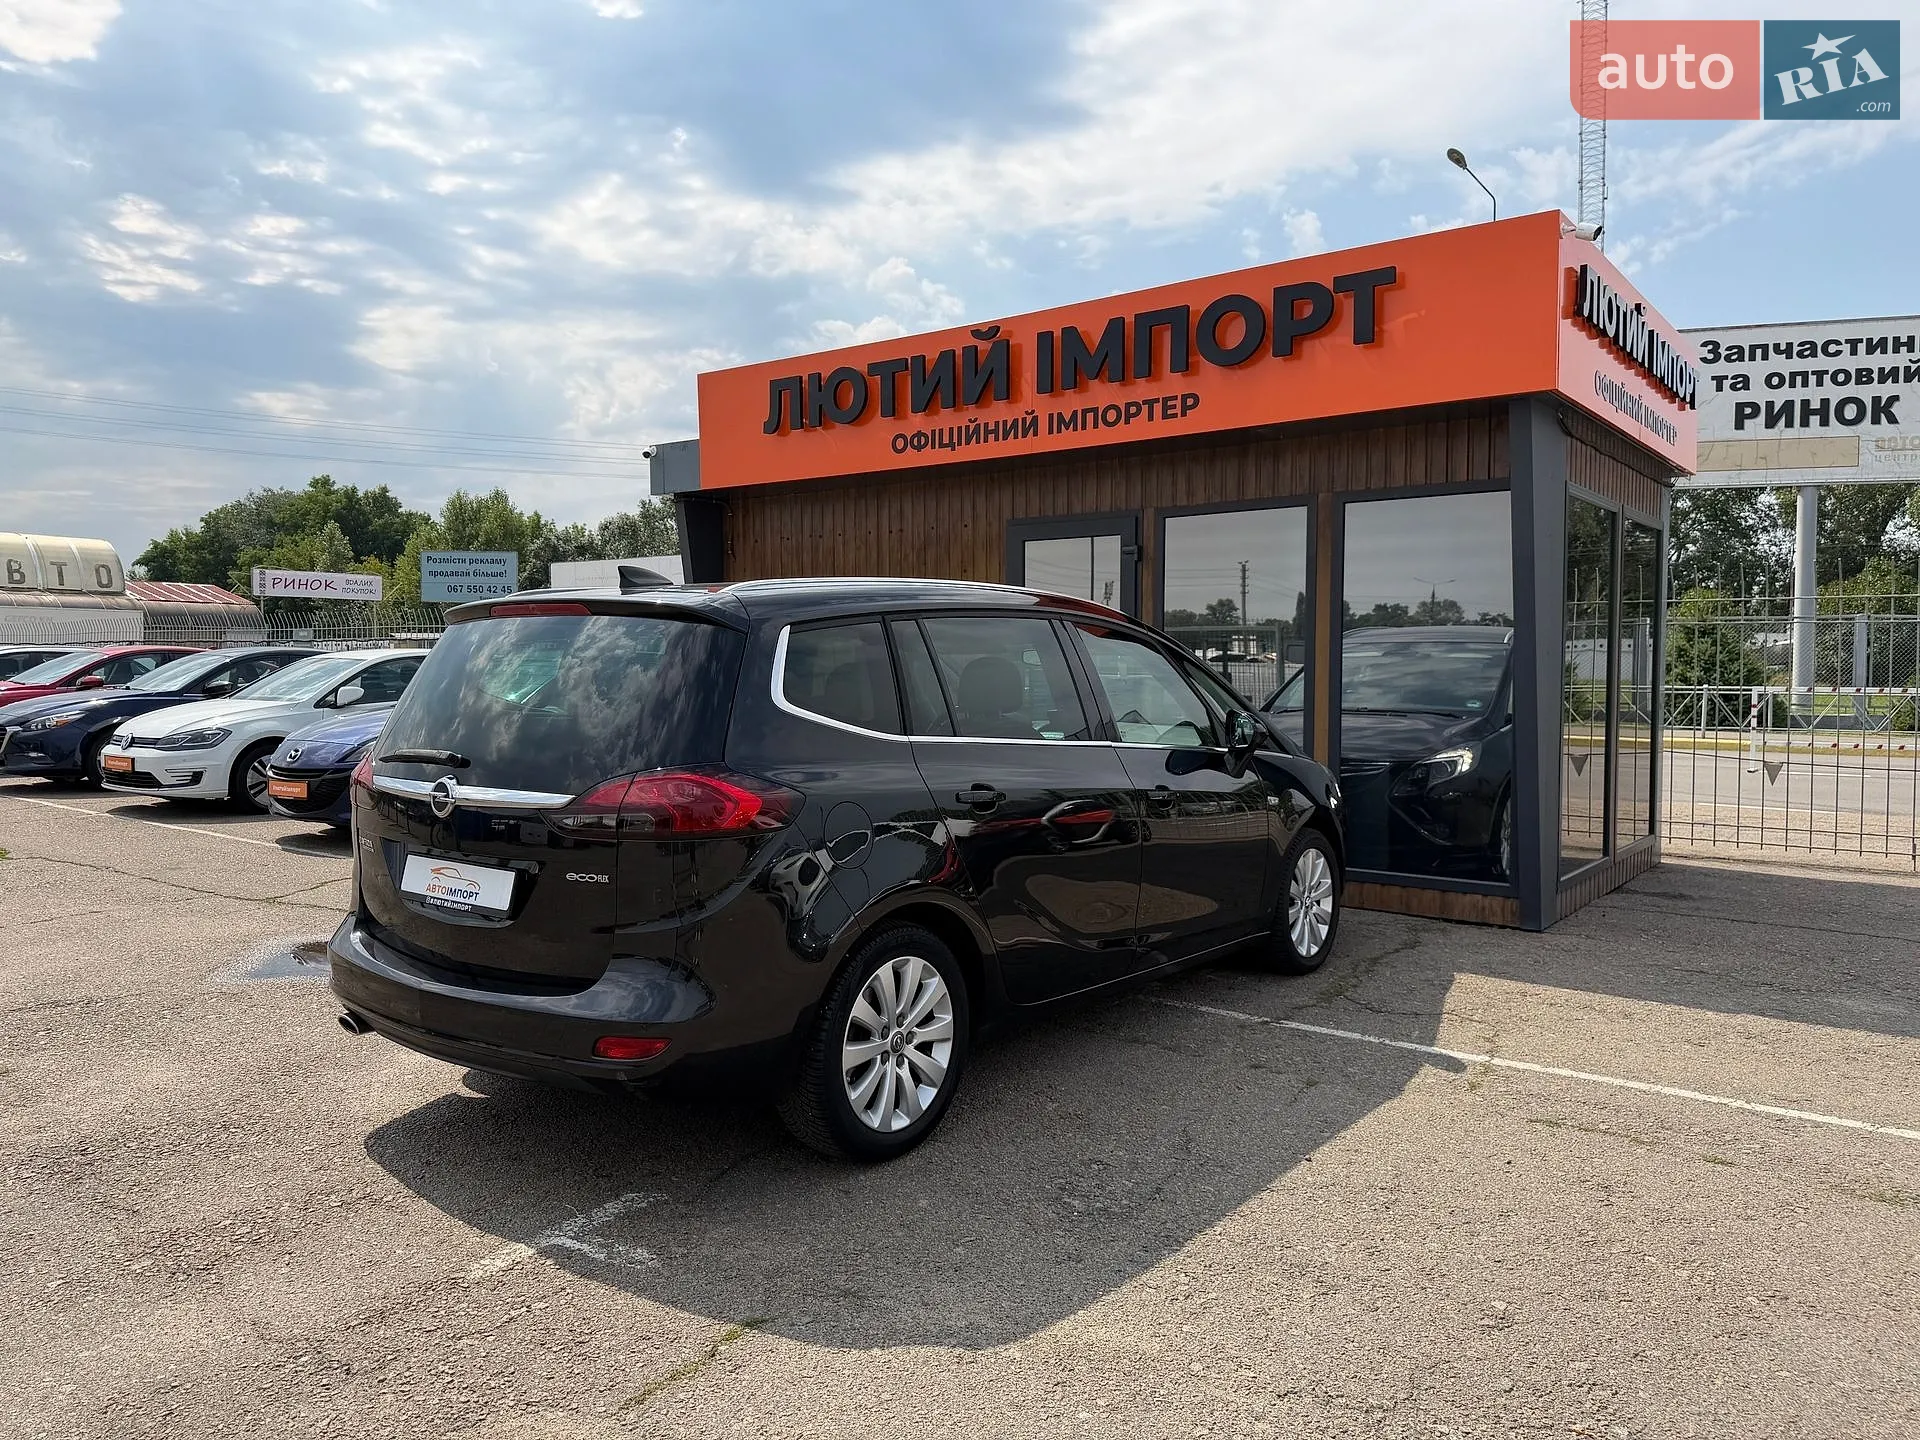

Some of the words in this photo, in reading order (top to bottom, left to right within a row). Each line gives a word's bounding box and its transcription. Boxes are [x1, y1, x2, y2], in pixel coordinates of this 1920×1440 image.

[1579, 264, 1649, 369] ЛЮТИЙ
[763, 325, 1011, 435] ЛЮТИЙ
[1036, 265, 1397, 395] ІМПОРТ
[1699, 334, 1920, 364] Запчастин
[1711, 373, 1751, 392] та
[1763, 358, 1920, 389] оптовий
[890, 409, 1040, 455] ОФІЦІЙНИЙ
[1047, 392, 1201, 436] ІМПОРТЕР
[1733, 394, 1901, 430] РИНОК
[426, 555, 466, 565] Розмісти
[468, 557, 507, 567] рекламу
[428, 568, 470, 578] продавай
[472, 569, 507, 578] більше!
[271, 577, 338, 591] РИНОК
[447, 584, 464, 594] 067
[466, 585, 484, 594] 550
[486, 585, 498, 594] 42
[500, 585, 513, 594] 45
[425, 883, 480, 901] АВТОІМПОРТ
